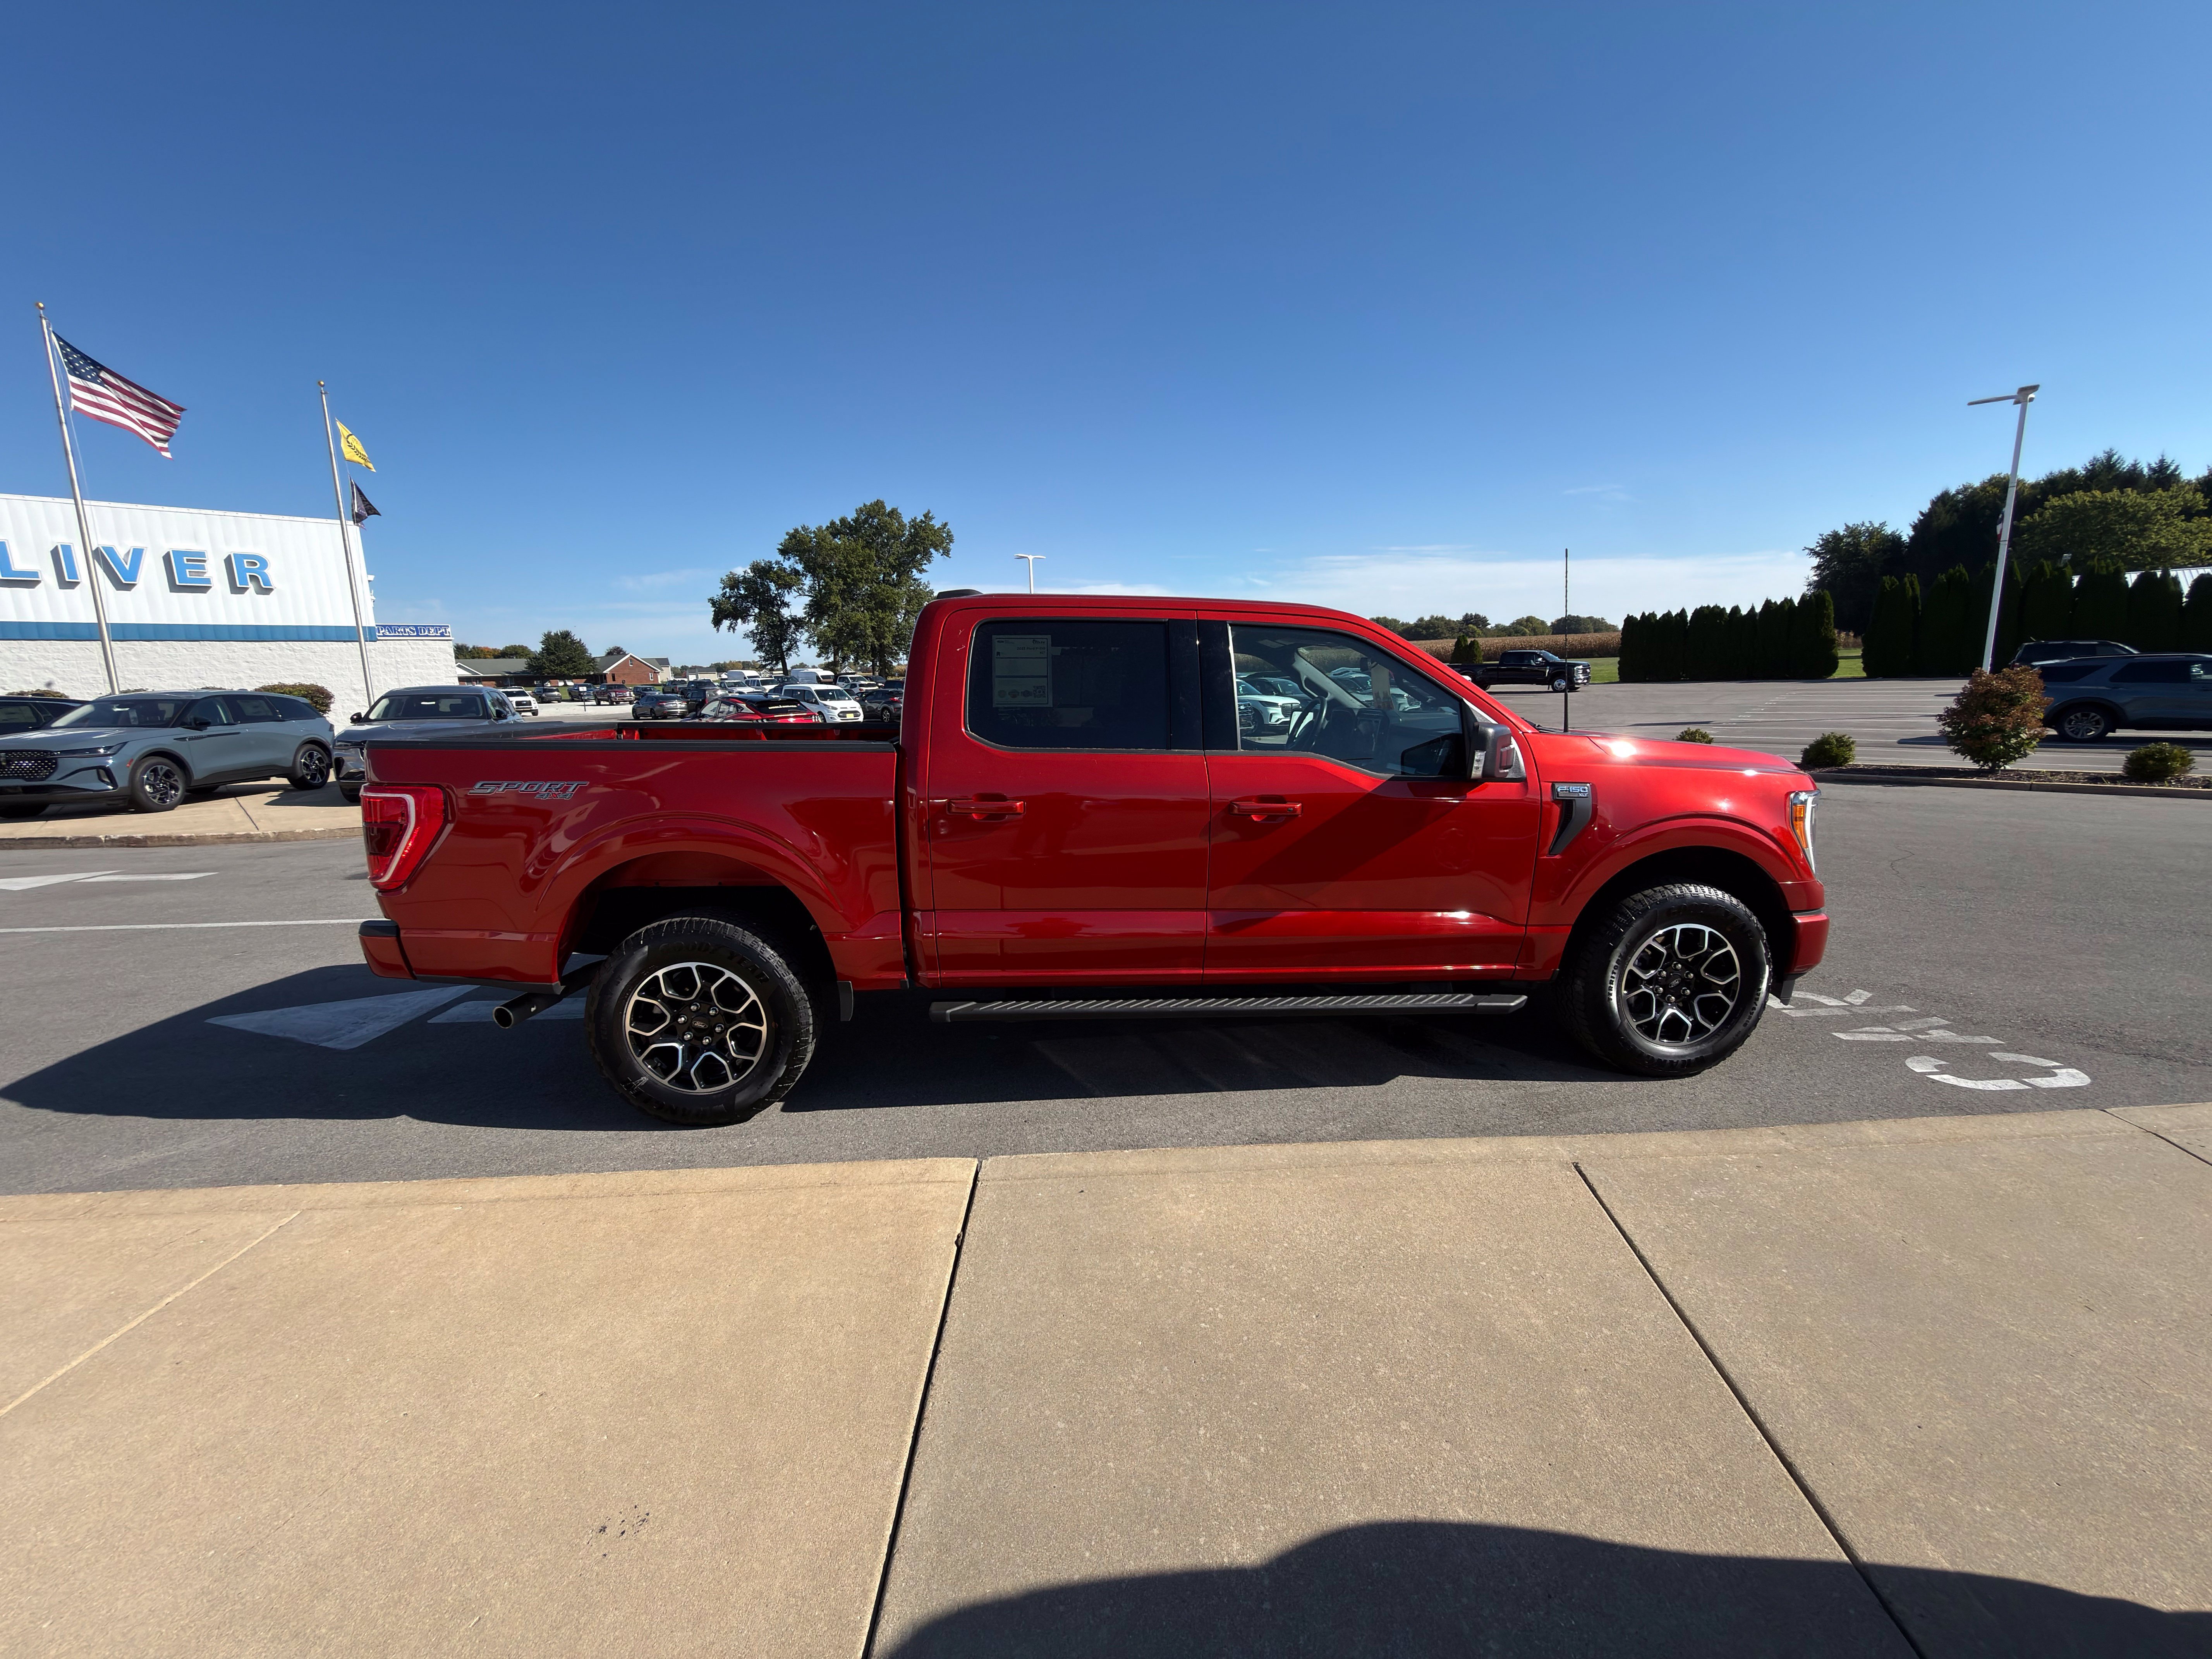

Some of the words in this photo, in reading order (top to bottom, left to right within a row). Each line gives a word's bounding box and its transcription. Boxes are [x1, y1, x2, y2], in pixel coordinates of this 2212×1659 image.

[376, 626, 416, 635] PARTS
[418, 627, 450, 636] DEPT
[467, 781, 589, 795] SPORT
[1608, 952, 1623, 1001] TERRITORY
